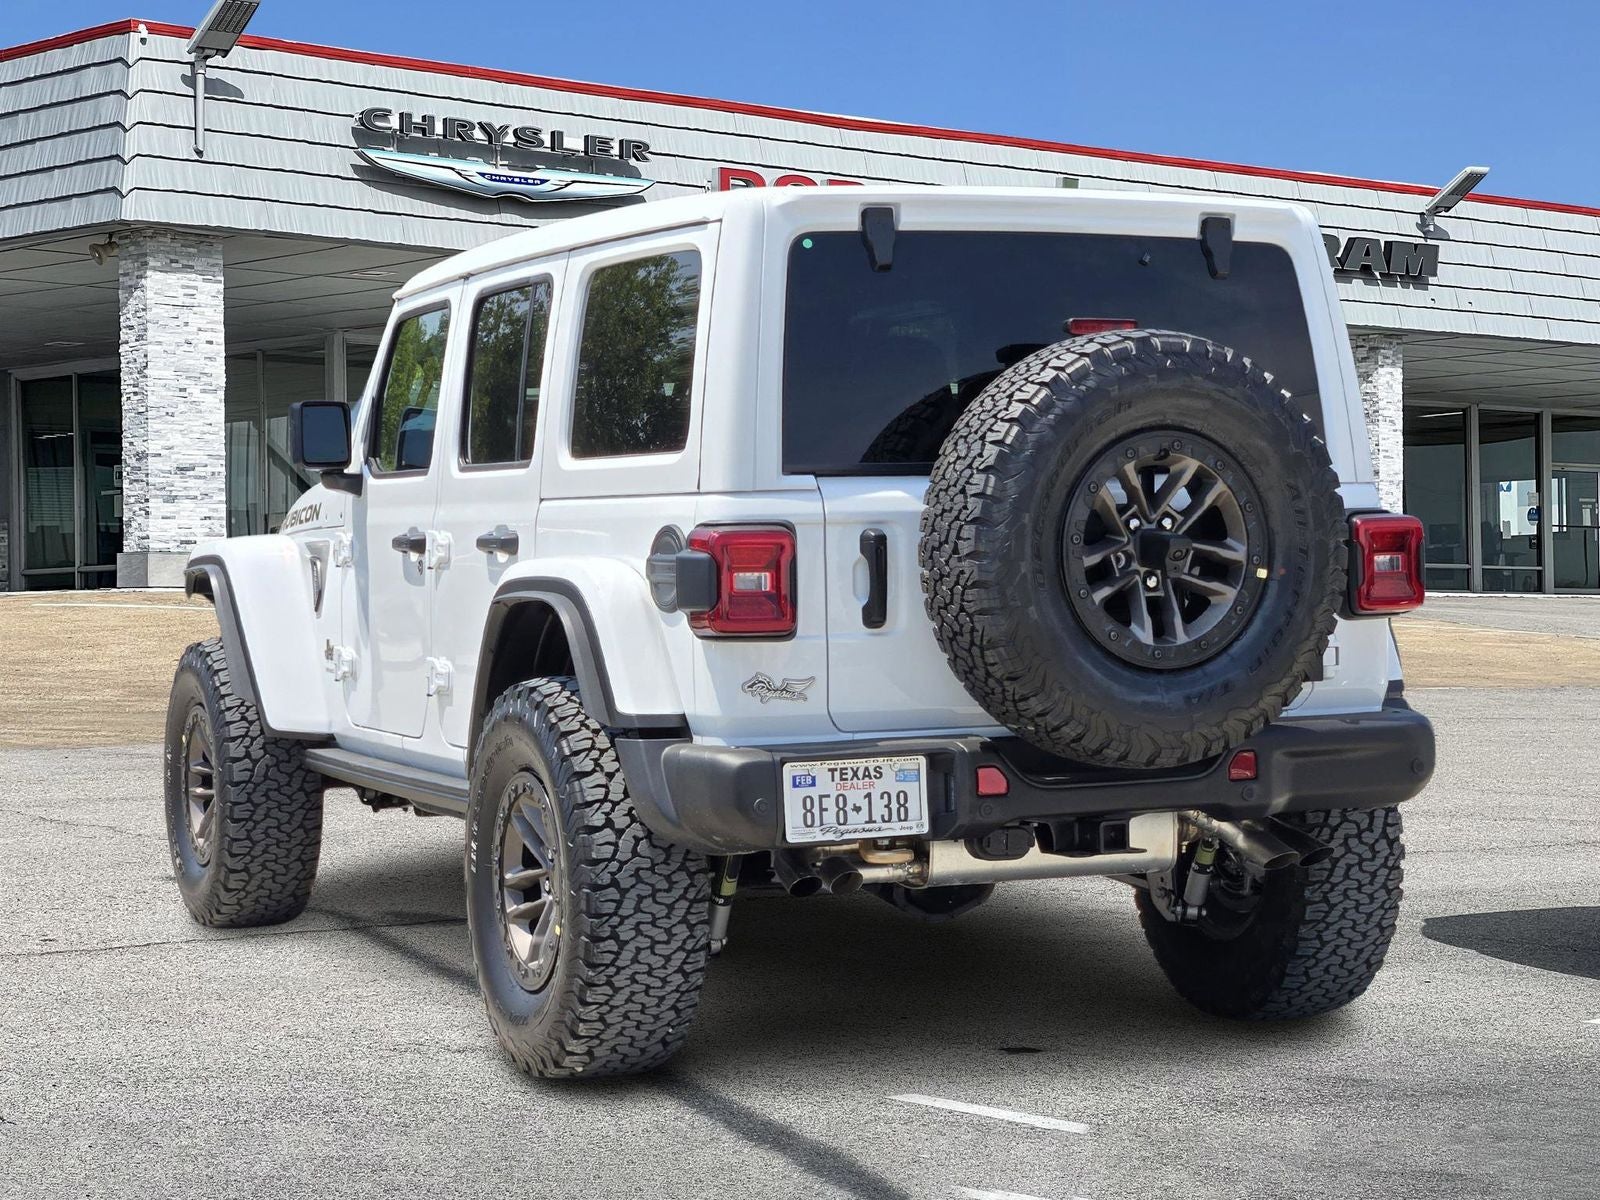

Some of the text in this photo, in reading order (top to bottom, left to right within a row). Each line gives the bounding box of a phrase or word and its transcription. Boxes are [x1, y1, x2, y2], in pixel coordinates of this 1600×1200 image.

[359, 107, 651, 162] CHRYSLER
[484, 174, 541, 185] CHRYSLER
[796, 775, 812, 786] FEB
[827, 765, 884, 782] TEXAS
[836, 781, 876, 792] DEALER
[863, 790, 909, 824] 138
